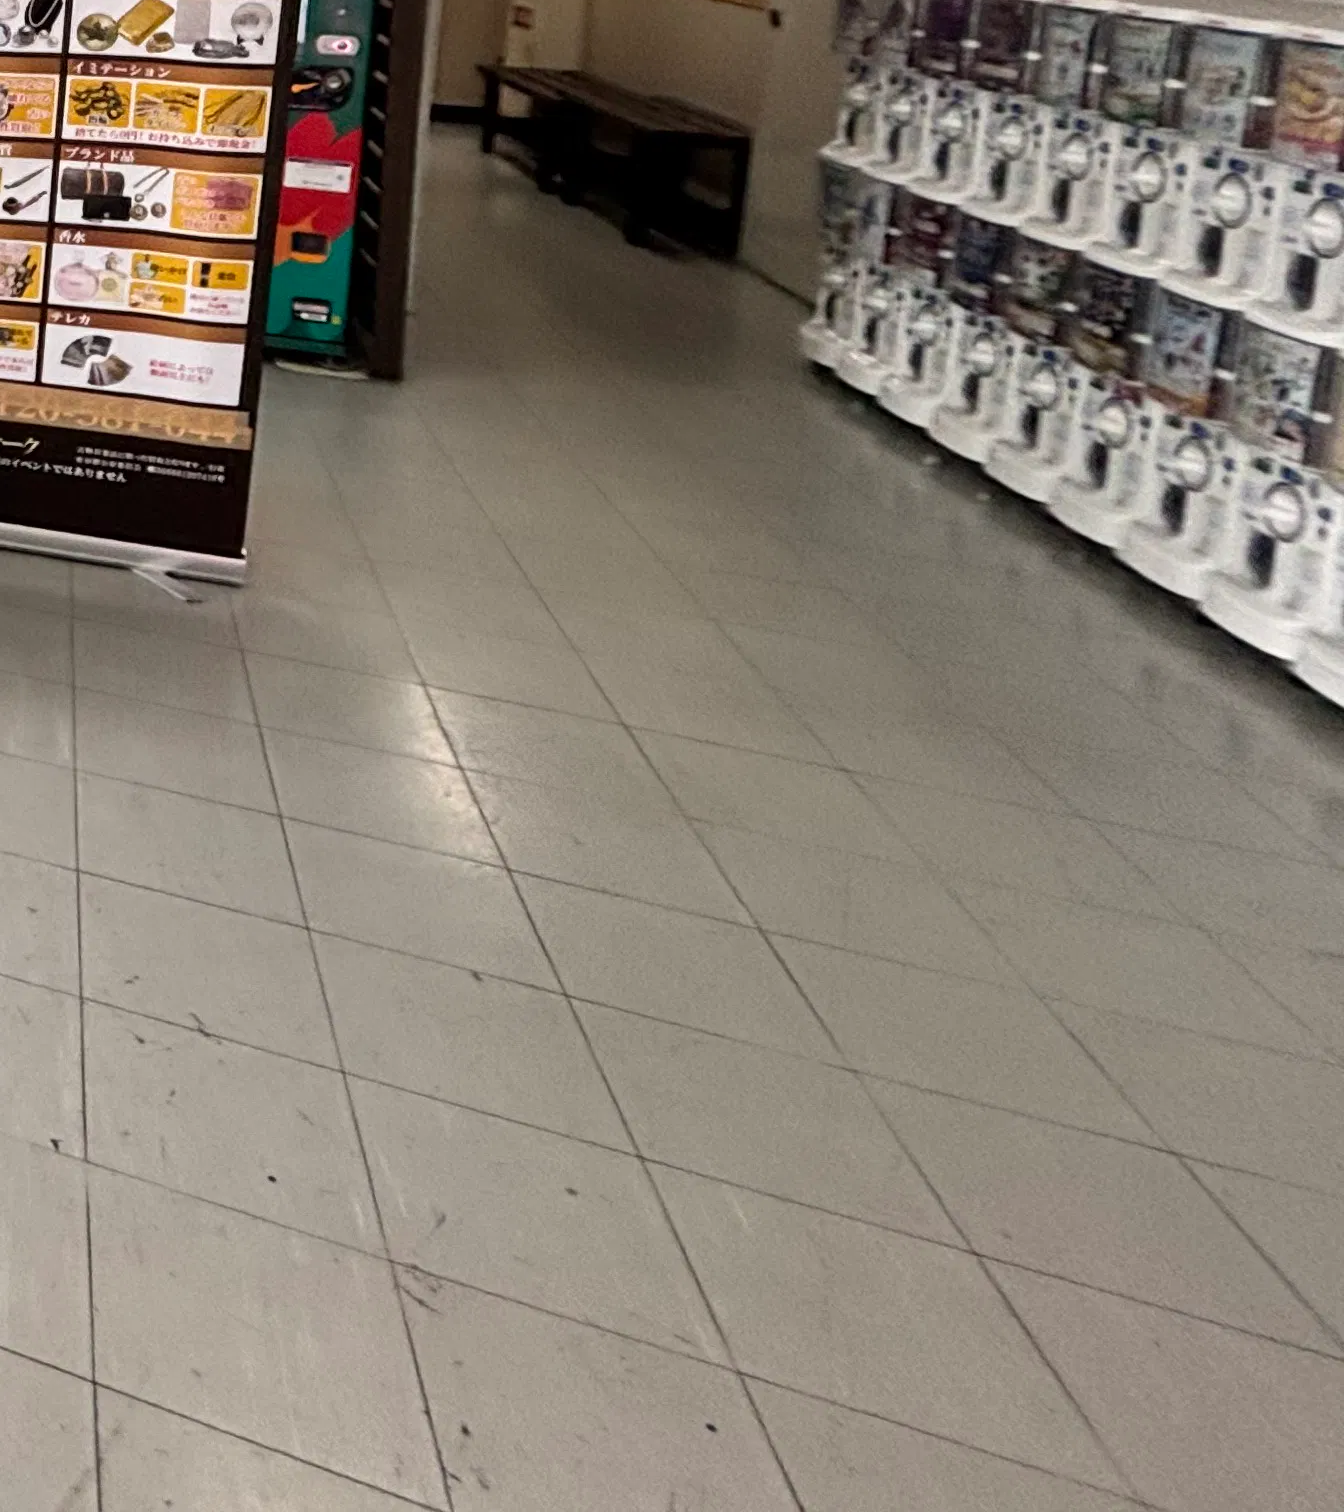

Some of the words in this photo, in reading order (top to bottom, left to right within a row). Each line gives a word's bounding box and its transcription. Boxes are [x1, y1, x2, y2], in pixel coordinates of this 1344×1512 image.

[74, 61, 171, 79] イミテーション
[64, 146, 135, 164] ブランド品
[50, 311, 91, 326] テレカ
